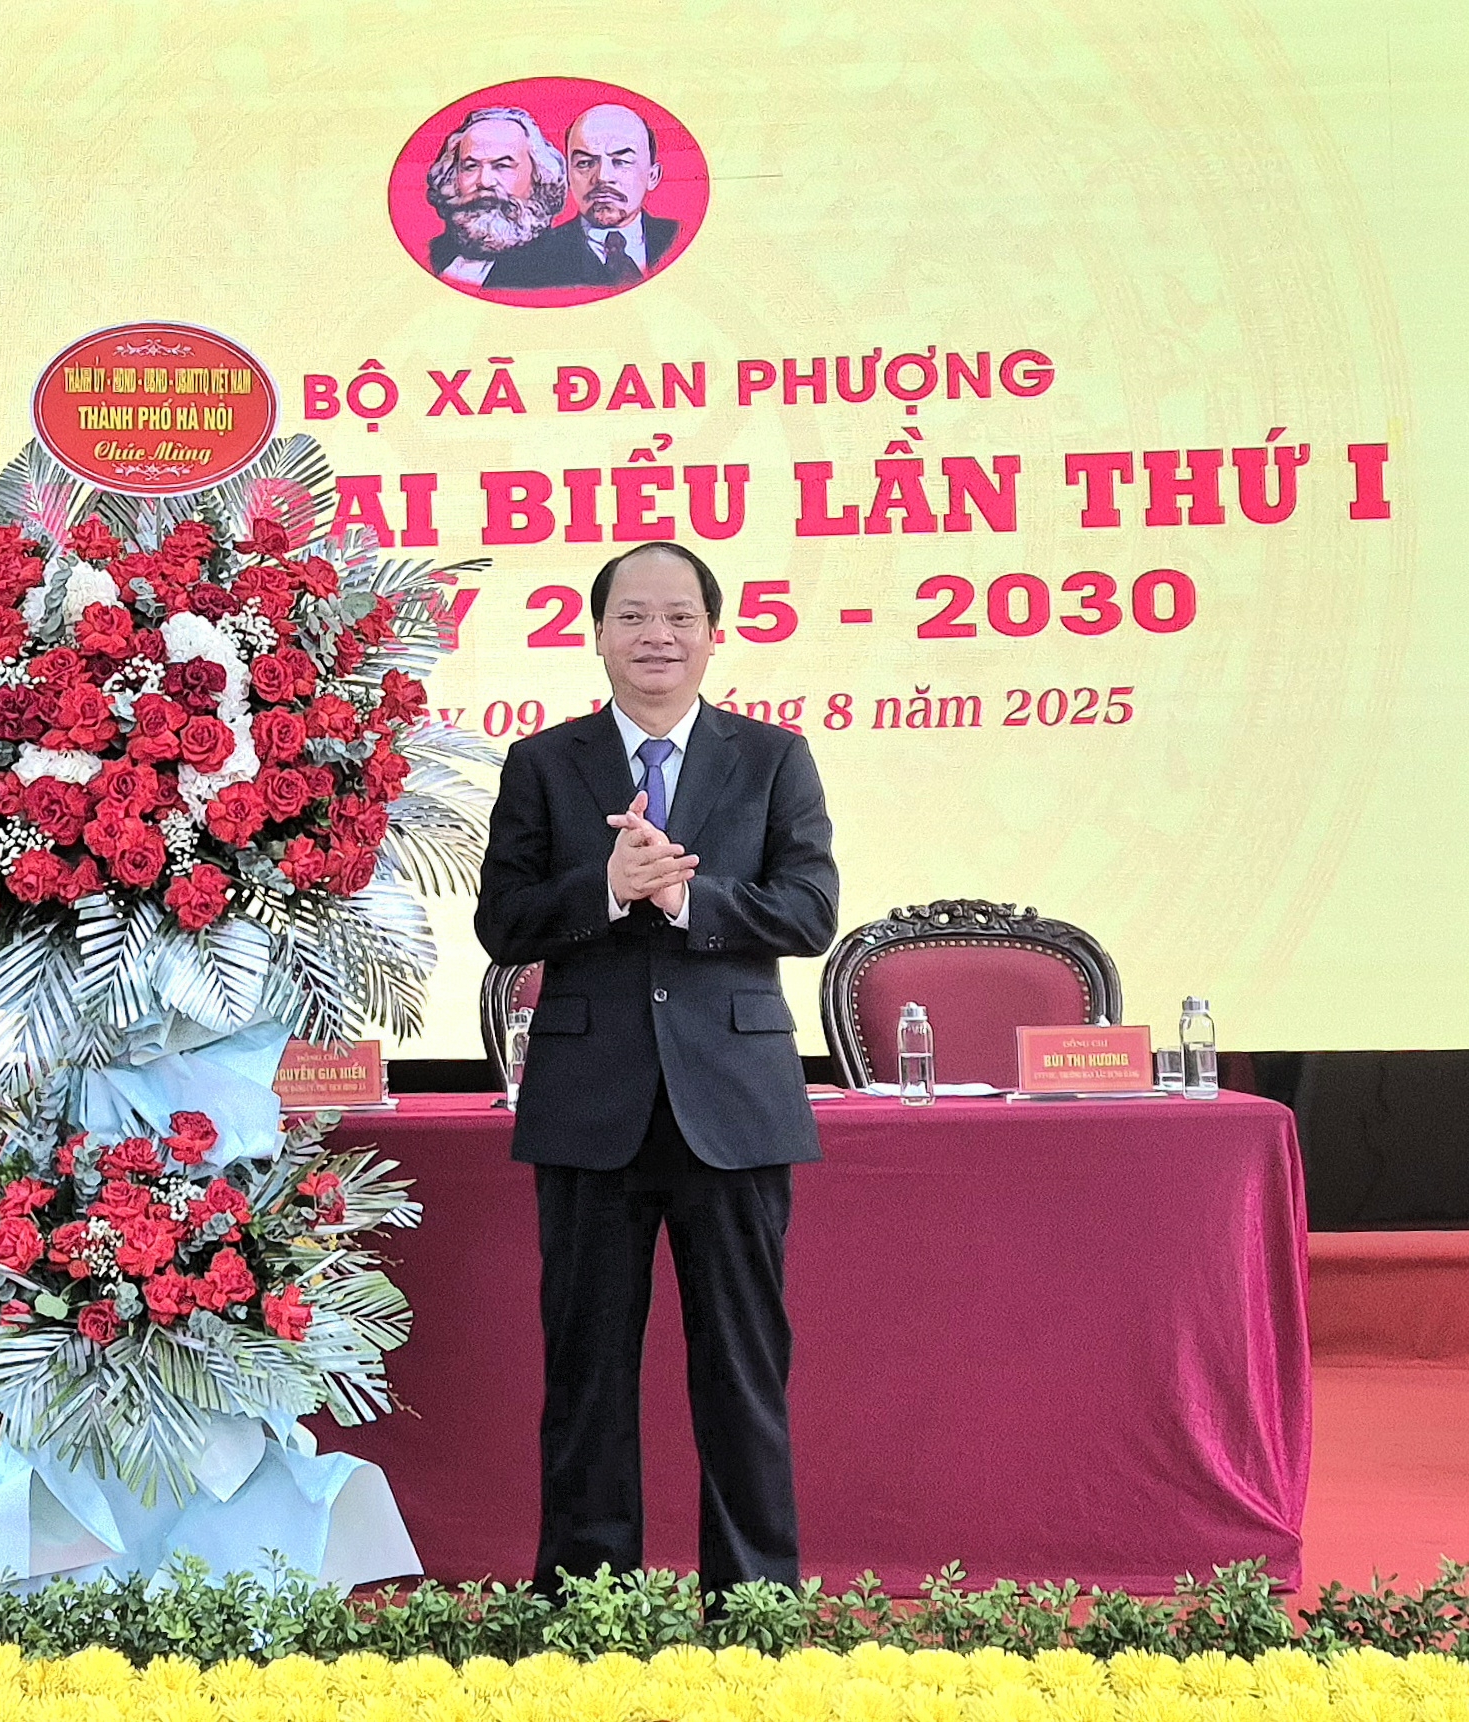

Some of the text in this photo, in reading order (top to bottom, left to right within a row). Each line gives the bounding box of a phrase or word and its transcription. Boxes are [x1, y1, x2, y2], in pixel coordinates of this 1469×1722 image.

[304, 345, 1056, 432] BỘ XÃ ĐAN PHƯỢNG
[78, 398, 233, 436] THÀNH PHỐ HÀ NỘI
[93, 440, 213, 465] Chúc Mừng
[480, 433, 750, 546] BIỂU
[794, 426, 1021, 536] LẦN
[1065, 427, 1311, 527] THỨ
[1347, 442, 1392, 520] I
[525, 579, 799, 648] 25
[840, 608, 873, 624] -
[915, 568, 1198, 639] 2030
[483, 699, 545, 738] 09
[823, 693, 854, 731] 8
[872, 684, 983, 730] năm
[1002, 686, 1135, 727] 2025
[318, 1067, 338, 1080] GIA
[1043, 1052, 1129, 1069] BÙI THỊ HƯƠNG
